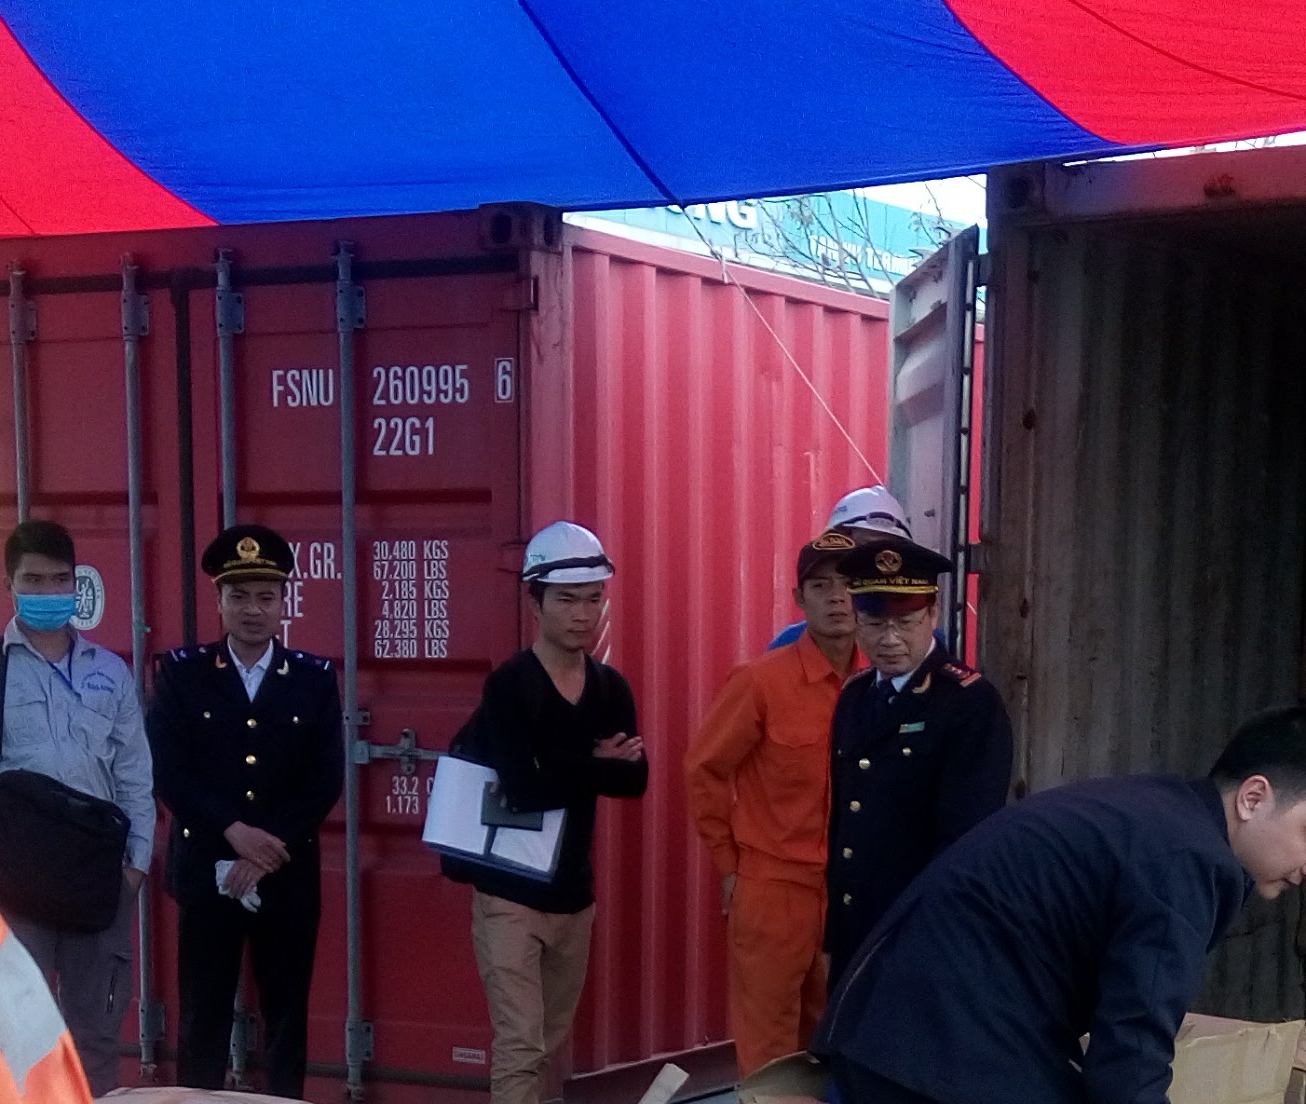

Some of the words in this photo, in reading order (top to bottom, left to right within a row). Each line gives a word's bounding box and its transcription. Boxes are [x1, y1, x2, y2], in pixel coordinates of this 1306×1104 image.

[271, 368, 334, 408] FSNU
[373, 364, 470, 406] 260995
[496, 360, 512, 400] 6
[373, 416, 435, 456] 22G1
[423, 540, 449, 560] KGS
[288, 542, 342, 579] X.GR.
[373, 561, 417, 580] 67.200
[424, 561, 446, 579] LBS
[382, 581, 417, 600] 2.185
[424, 580, 449, 600] KGS
[382, 600, 417, 619] 4.820
[425, 600, 447, 619] LBS
[374, 620, 417, 639] 28.295
[425, 620, 450, 639] KGS
[374, 639, 417, 659] 62.380
[425, 639, 448, 659] LBS
[391, 775, 419, 795] 33.2
[386, 795, 420, 815] 1.173
